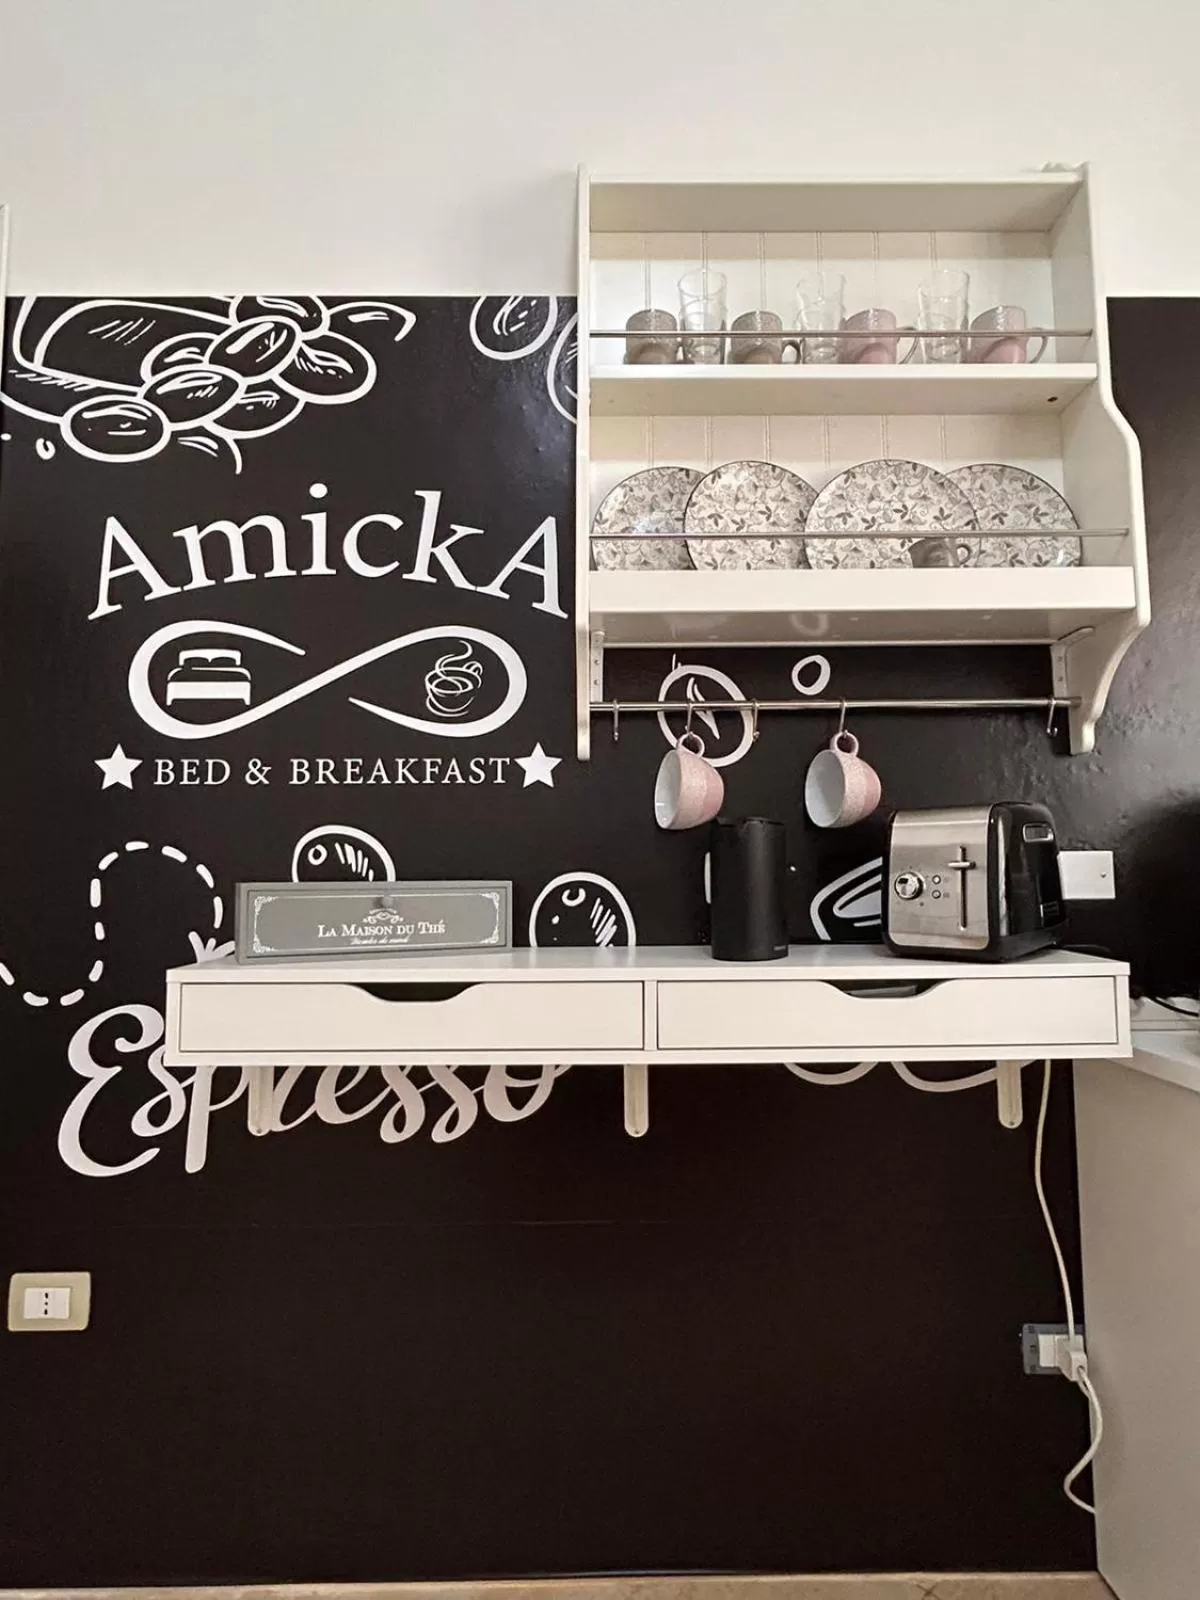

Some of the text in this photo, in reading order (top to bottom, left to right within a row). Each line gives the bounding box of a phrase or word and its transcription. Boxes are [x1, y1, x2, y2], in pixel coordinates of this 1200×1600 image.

[88, 483, 568, 620] AmickA
[153, 757, 510, 785] BED & BREAKFAST
